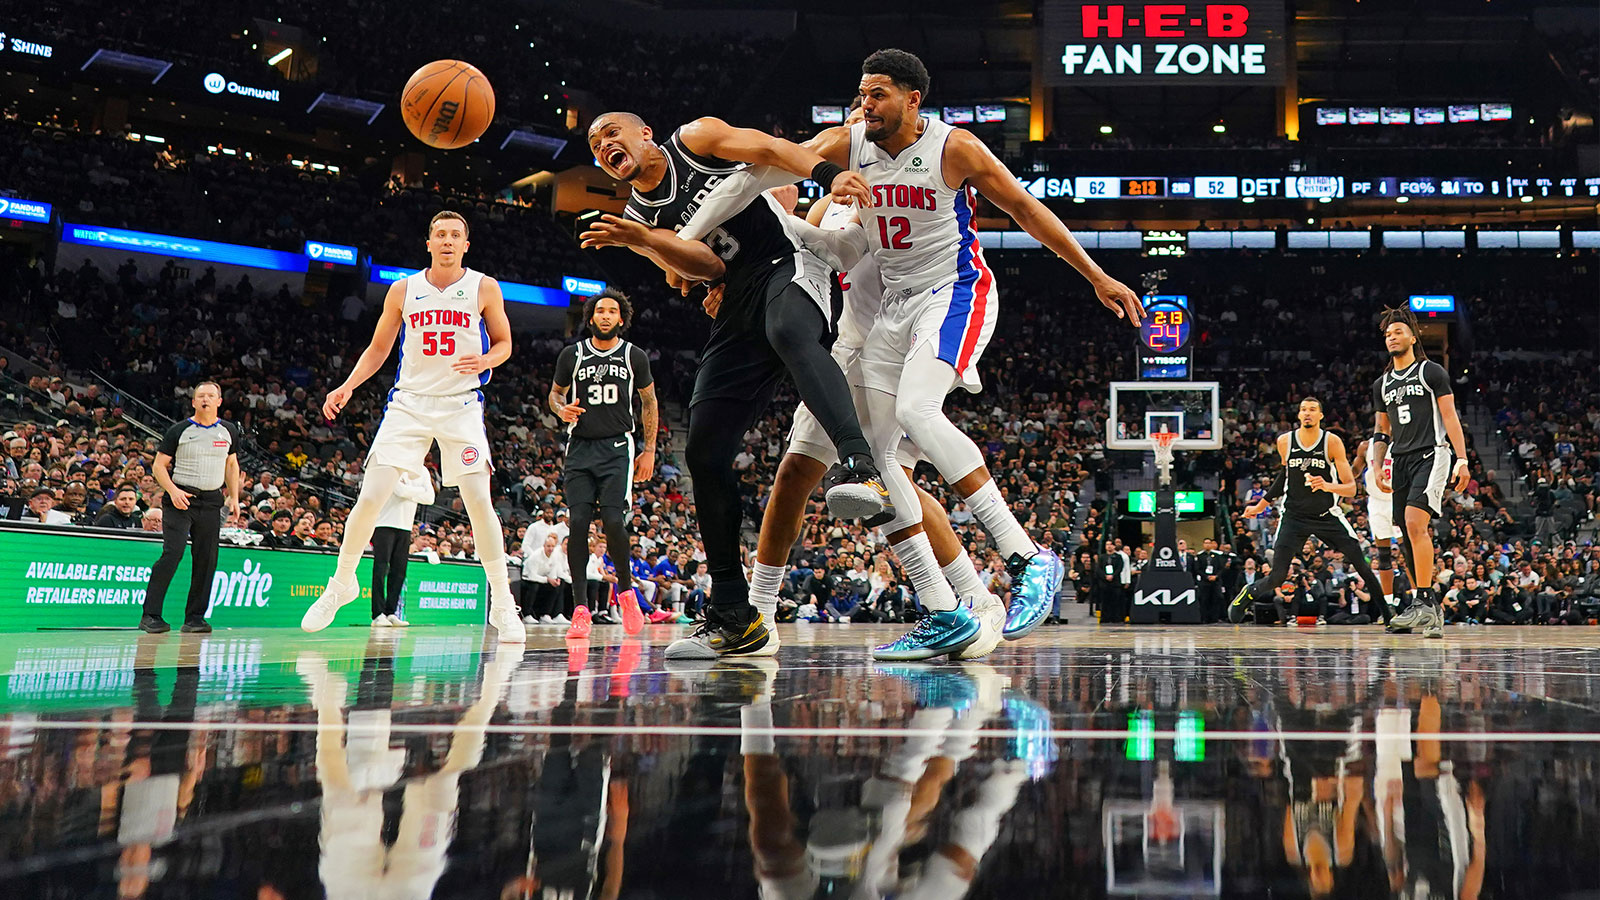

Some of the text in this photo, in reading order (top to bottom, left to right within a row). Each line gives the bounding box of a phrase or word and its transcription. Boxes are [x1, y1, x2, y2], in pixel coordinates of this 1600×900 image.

[1081, 4, 1250, 38] H-E-B
[1062, 44, 1266, 75] FAN ZONE
[227, 81, 280, 102] Ownwell
[1046, 178, 1074, 197] SA
[1089, 181, 1106, 195] 62
[1128, 180, 1157, 195] 2:13
[1208, 181, 1225, 195] 52
[1241, 178, 1280, 196] DET
[1351, 182, 1372, 194] PF
[1400, 181, 1436, 194] FG%
[1463, 181, 1484, 194] TO
[876, 215, 914, 250] 12
[408, 309, 472, 329] PISTONS
[1155, 311, 1183, 325] 2:13
[422, 331, 456, 356] 55
[1149, 324, 1181, 347] 24
[578, 363, 629, 384] SPURS
[587, 383, 618, 406] 30
[1384, 384, 1425, 406] SPURS
[1396, 404, 1411, 424] 5
[25, 561, 152, 582] AVAILABLE AT SELEC
[25, 587, 147, 605] RETAILERS NEAR YO
[204, 558, 274, 619] prite
[290, 585, 326, 597] LIMITED
